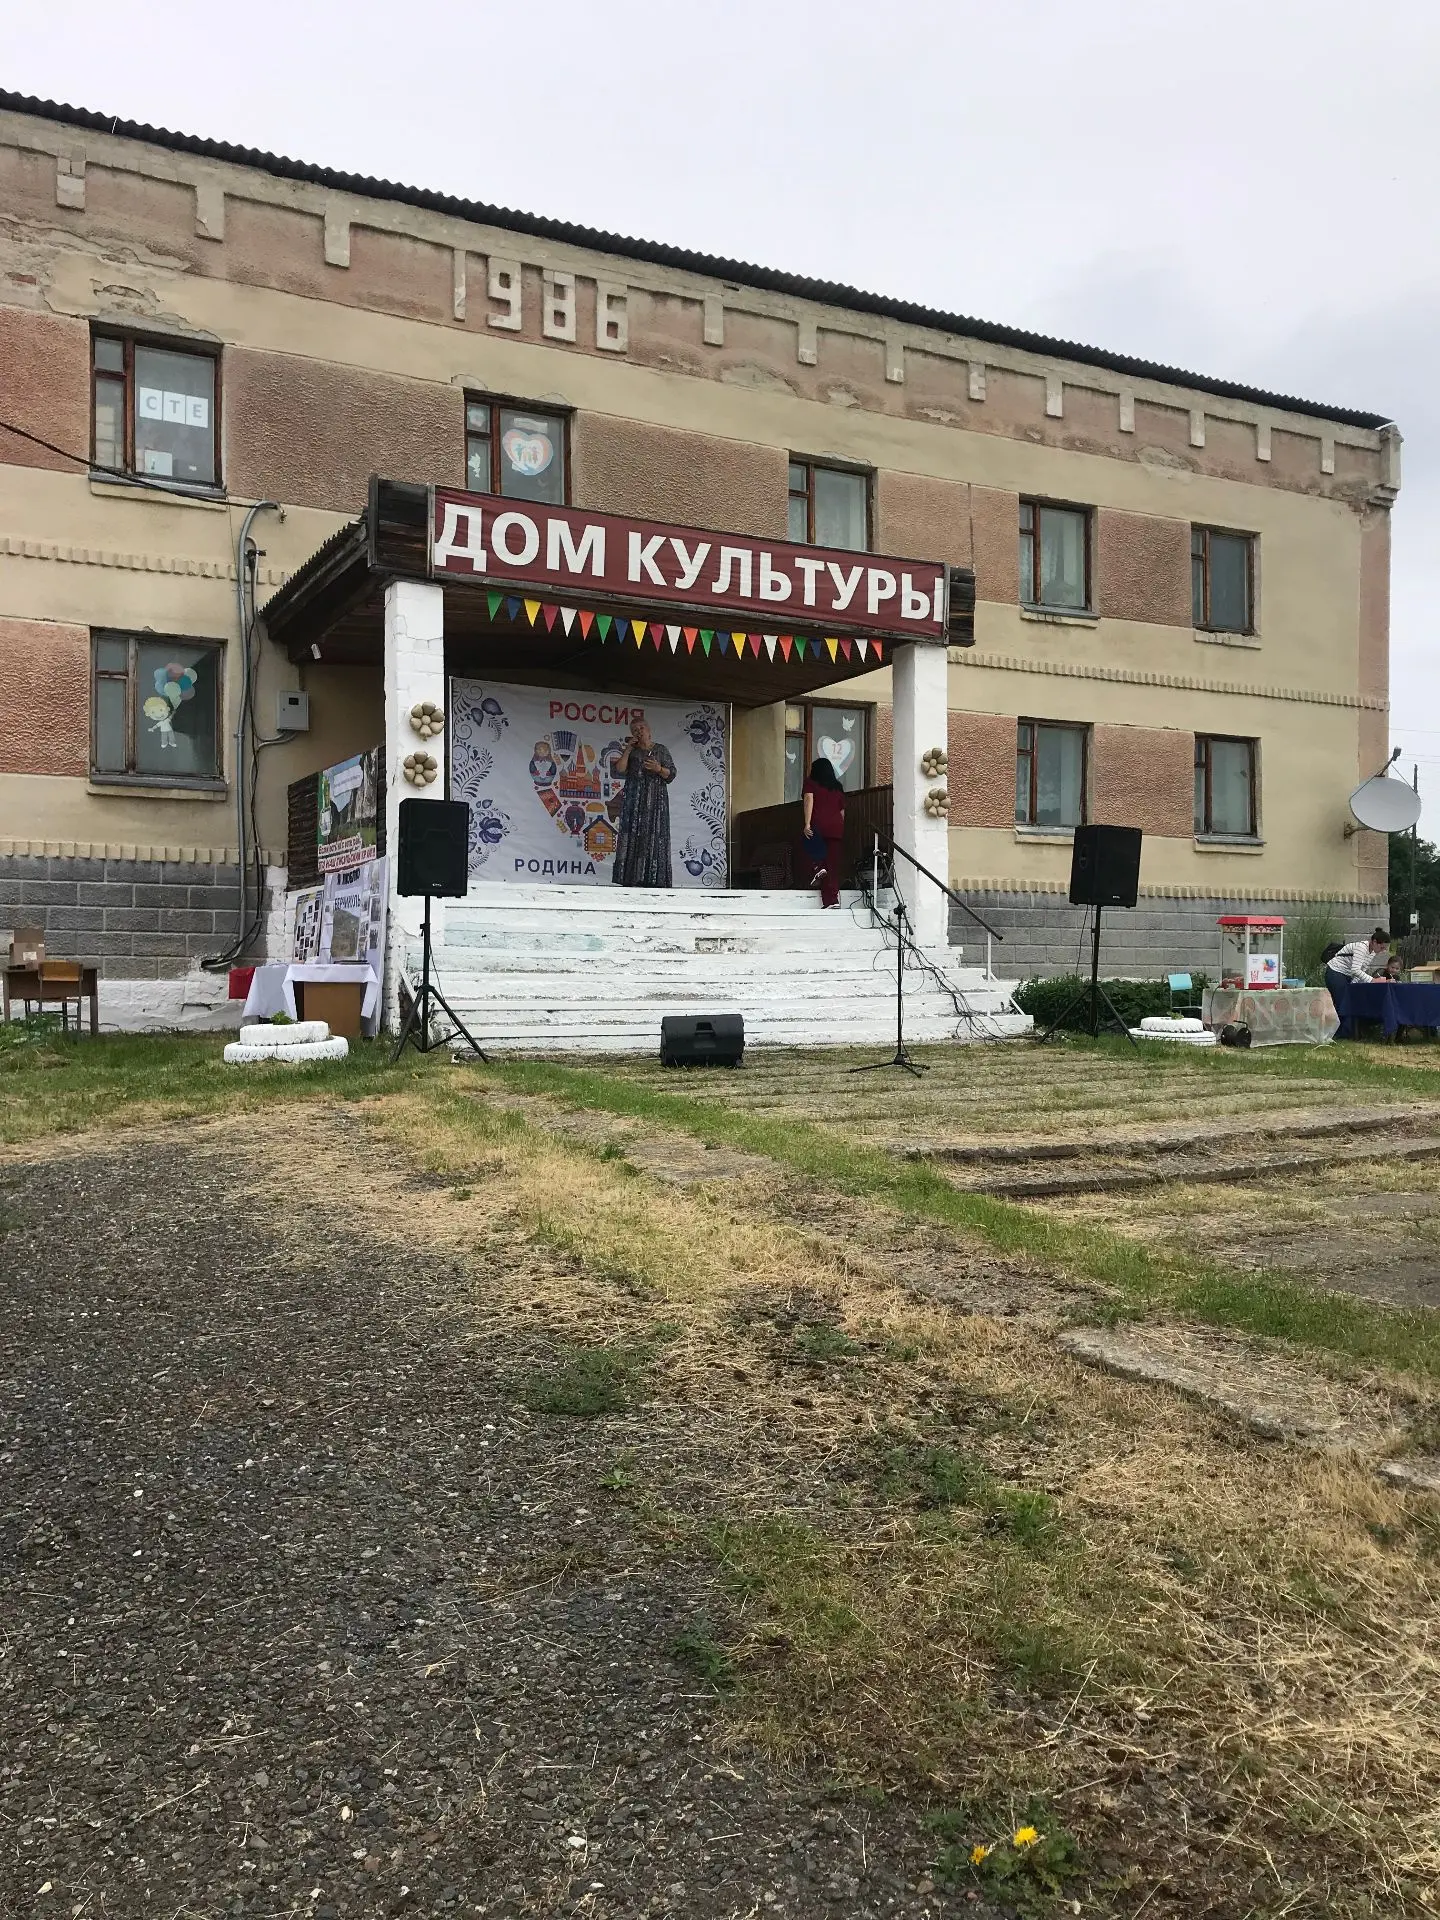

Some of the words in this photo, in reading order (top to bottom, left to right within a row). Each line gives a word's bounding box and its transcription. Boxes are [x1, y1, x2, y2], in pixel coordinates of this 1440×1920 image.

[453, 249, 627, 354] 1986
[435, 502, 606, 578] ДОМ
[626, 531, 944, 622] КУЛЬТУРЫ
[549, 700, 646, 725] РОССИЯ
[514, 858, 597, 876] РОДИНА
